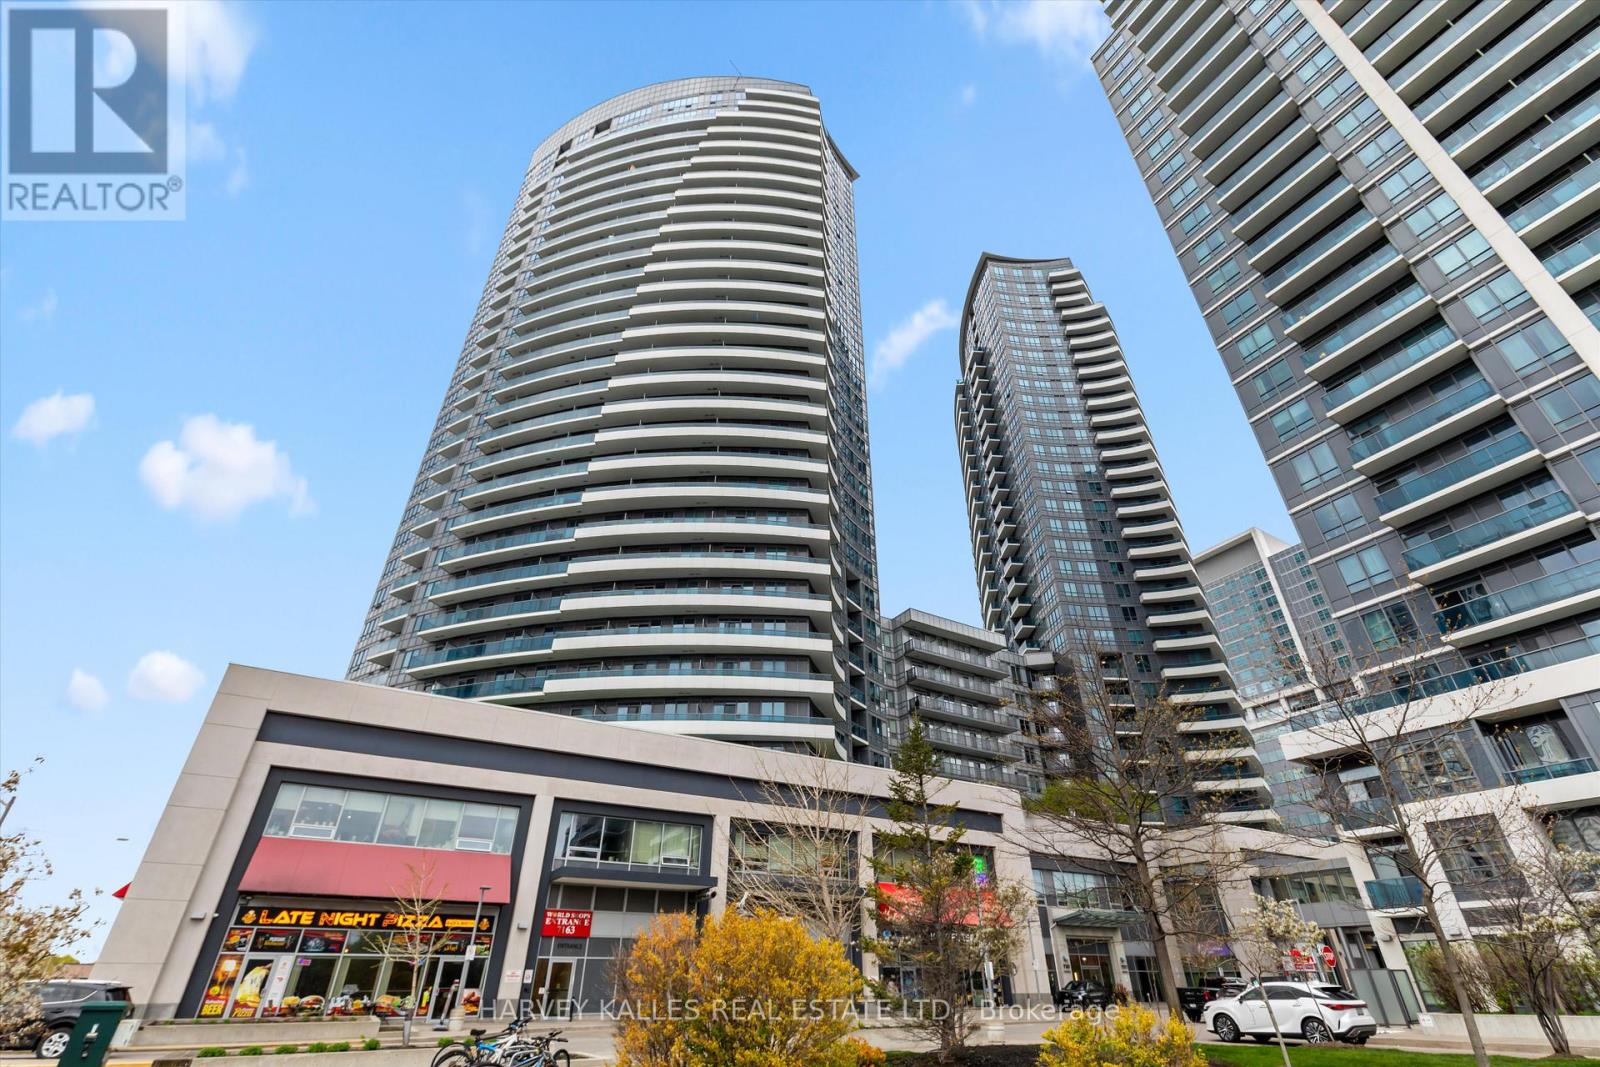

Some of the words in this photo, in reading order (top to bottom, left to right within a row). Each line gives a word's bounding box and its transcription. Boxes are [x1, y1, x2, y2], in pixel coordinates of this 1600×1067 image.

[259, 909, 315, 925] LATE
[318, 911, 382, 928] NIGHT
[382, 913, 444, 929] PIZZA
[201, 1004, 224, 1015] BEER
